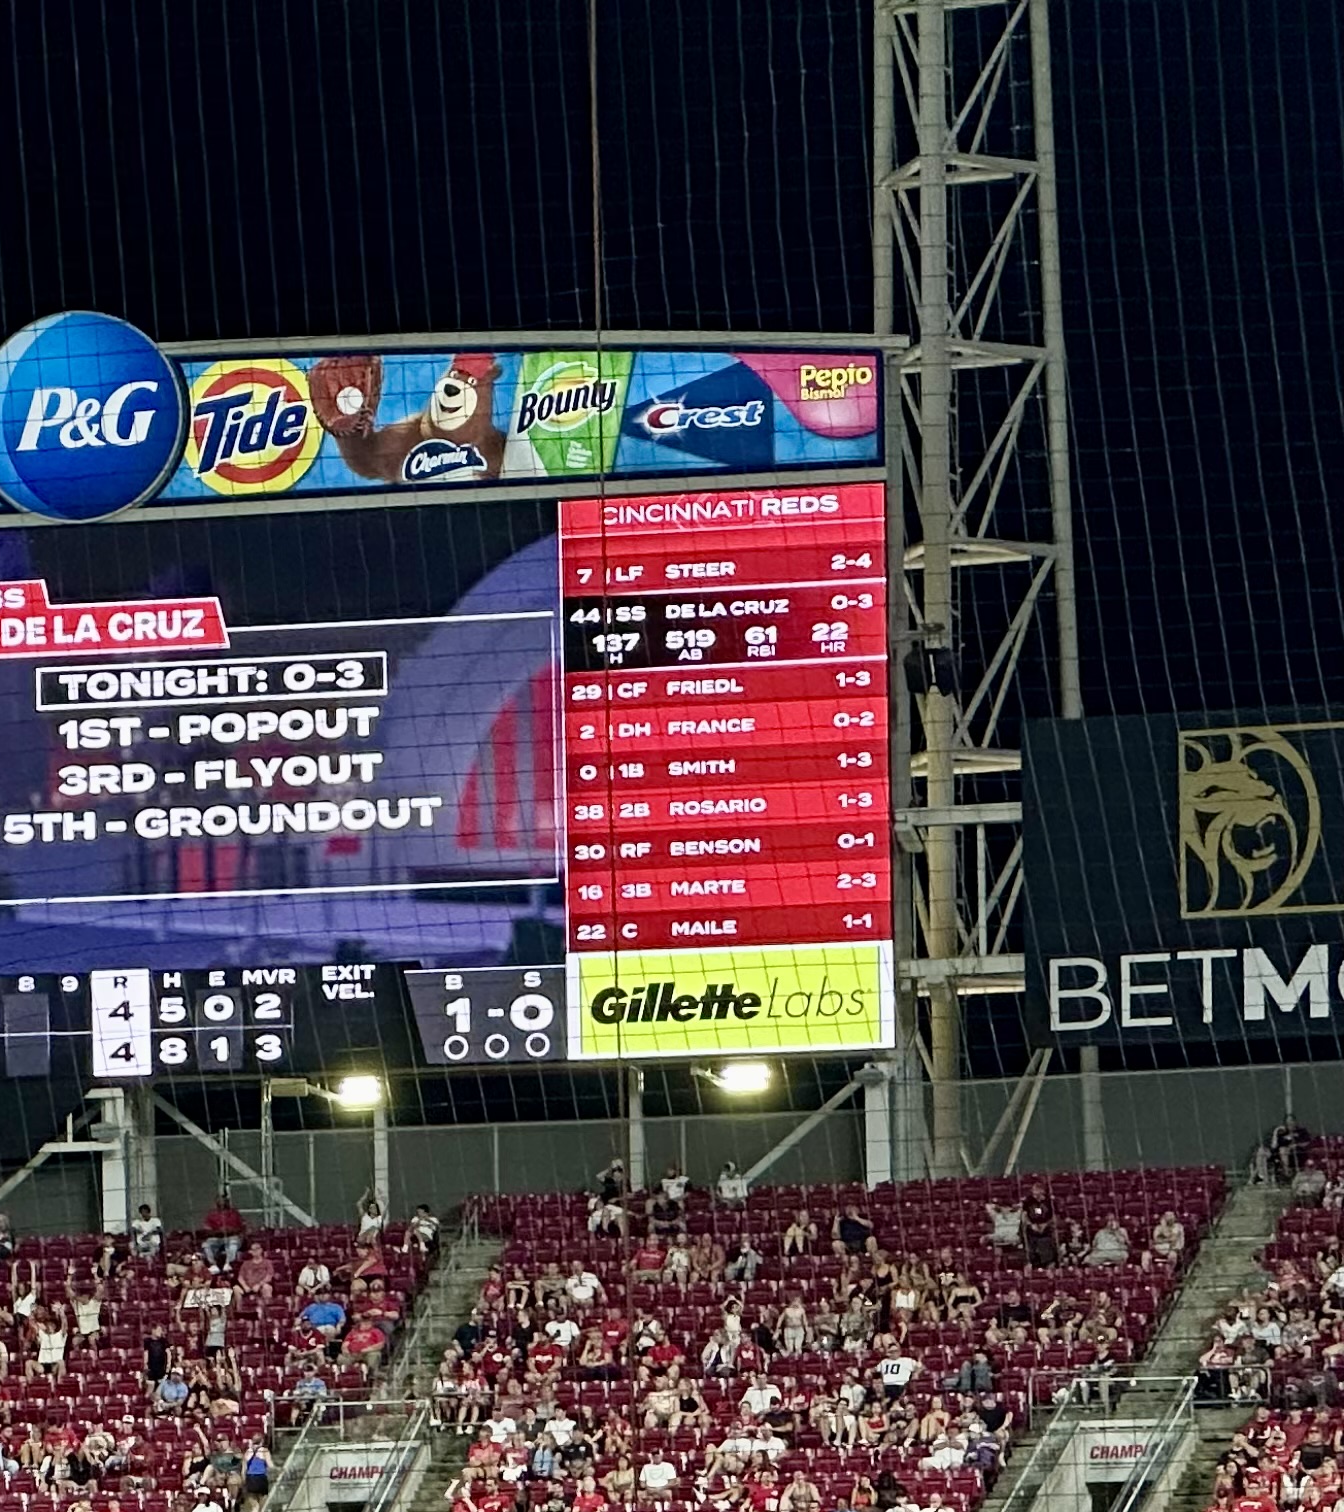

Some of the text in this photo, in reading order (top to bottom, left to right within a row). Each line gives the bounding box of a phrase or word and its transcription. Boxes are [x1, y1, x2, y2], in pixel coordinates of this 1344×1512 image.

[799, 364, 873, 391] Pepto
[799, 385, 846, 401] Bismol
[16, 380, 158, 451] P&G
[516, 377, 617, 435] Bounty
[646, 399, 765, 434] Crest
[194, 385, 308, 478] Tide
[410, 446, 468, 475] Charmin
[603, 494, 839, 526] CINCINNATI REDS
[576, 553, 872, 584] 7 LF STEER 2-4
[570, 594, 873, 624] 44 SS DE LA CRUZ 0-3
[0, 617, 47, 648] DE
[53, 614, 102, 645] LA
[107, 609, 206, 642] CRUZ
[592, 622, 849, 653] 137 519 61 22
[58, 659, 366, 702] TONIGHT: 0-3
[571, 671, 872, 701] 29 CF FRIEDL 1-3
[58, 704, 381, 750] 1ST POPOUT
[579, 712, 875, 739] 2 DH FRANCE 0-2
[58, 751, 384, 797] 3RD FLYOUT
[579, 752, 873, 780] 0 1B SMITH 1-3
[2, 796, 443, 844] 5TH GROUNDOUT
[574, 792, 873, 820] 38 2B ROSARIO 1-3
[574, 832, 875, 860] 30 RF BENSON 0-1
[578, 873, 877, 900] 16 3B MARTE 2-3
[577, 913, 873, 940] 22 C MAILE 1-1
[321, 964, 376, 981] EXIT
[1049, 943, 1344, 1032] BETM
[321, 982, 376, 1000] VEL.
[591, 975, 866, 1025] Gillette Labs
